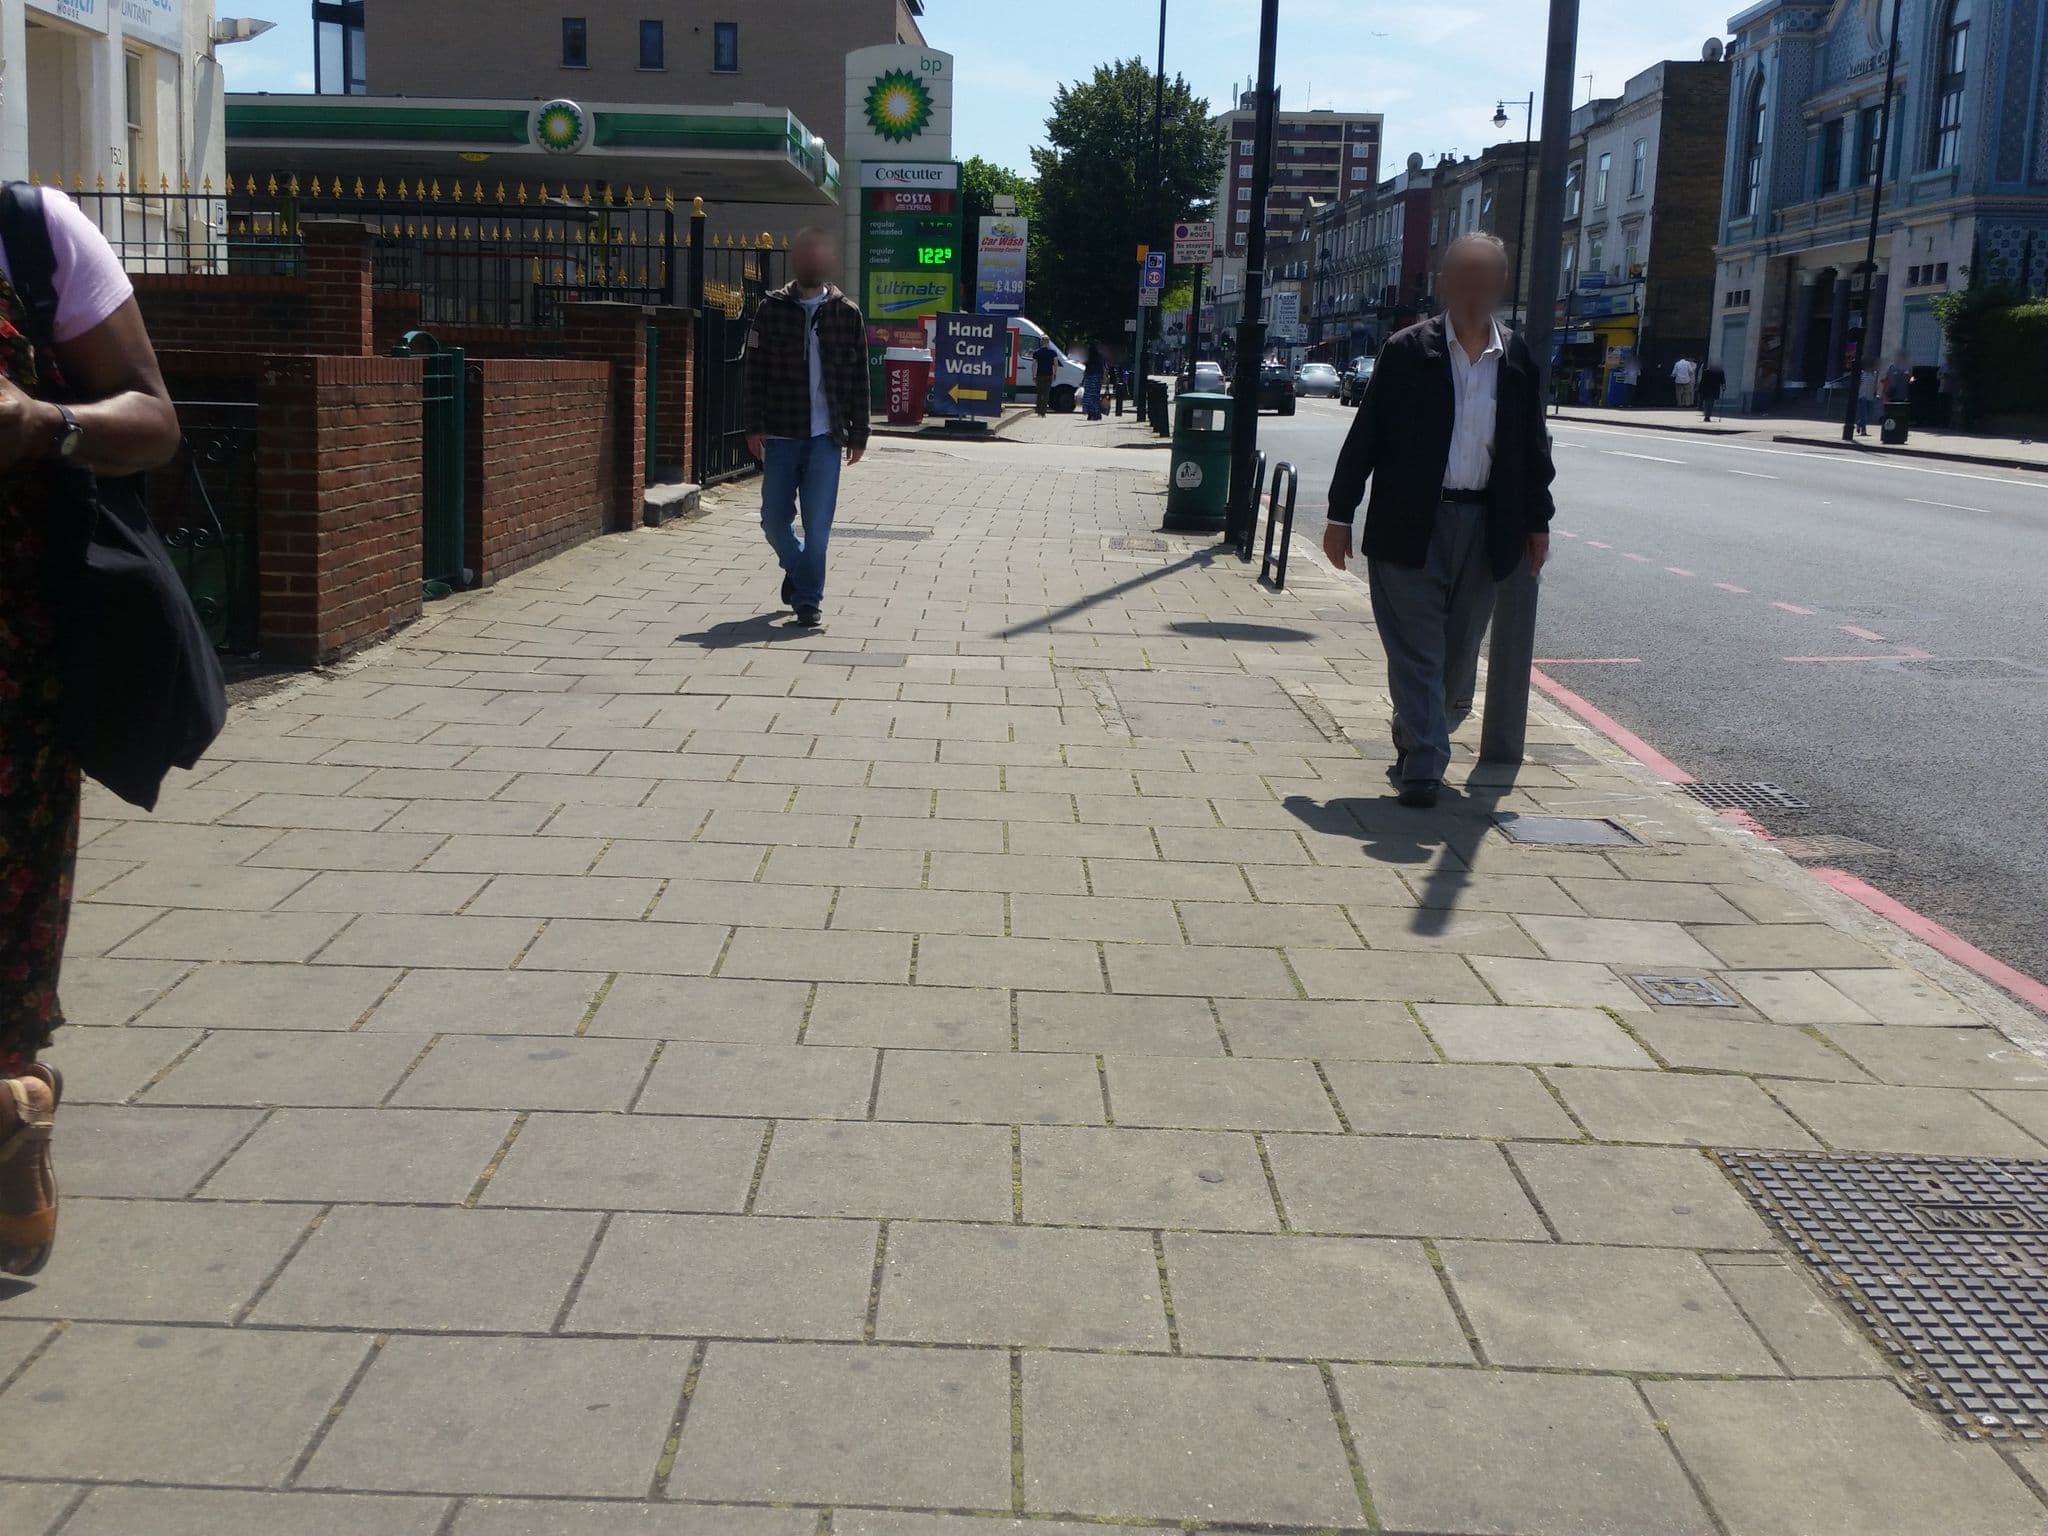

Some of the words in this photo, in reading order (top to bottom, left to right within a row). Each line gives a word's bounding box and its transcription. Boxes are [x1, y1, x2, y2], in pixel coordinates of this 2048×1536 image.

[920, 55, 942, 76] bp
[110, 146, 122, 166] 152
[875, 167, 943, 182] Costcutter
[895, 193, 932, 204] COSTA
[999, 236, 1025, 247] Wash
[948, 322, 994, 338] Hand
[955, 341, 985, 356] Car
[945, 359, 993, 376] Wash
[891, 369, 901, 413] COSTA
[902, 369, 910, 401] EXPRESS
